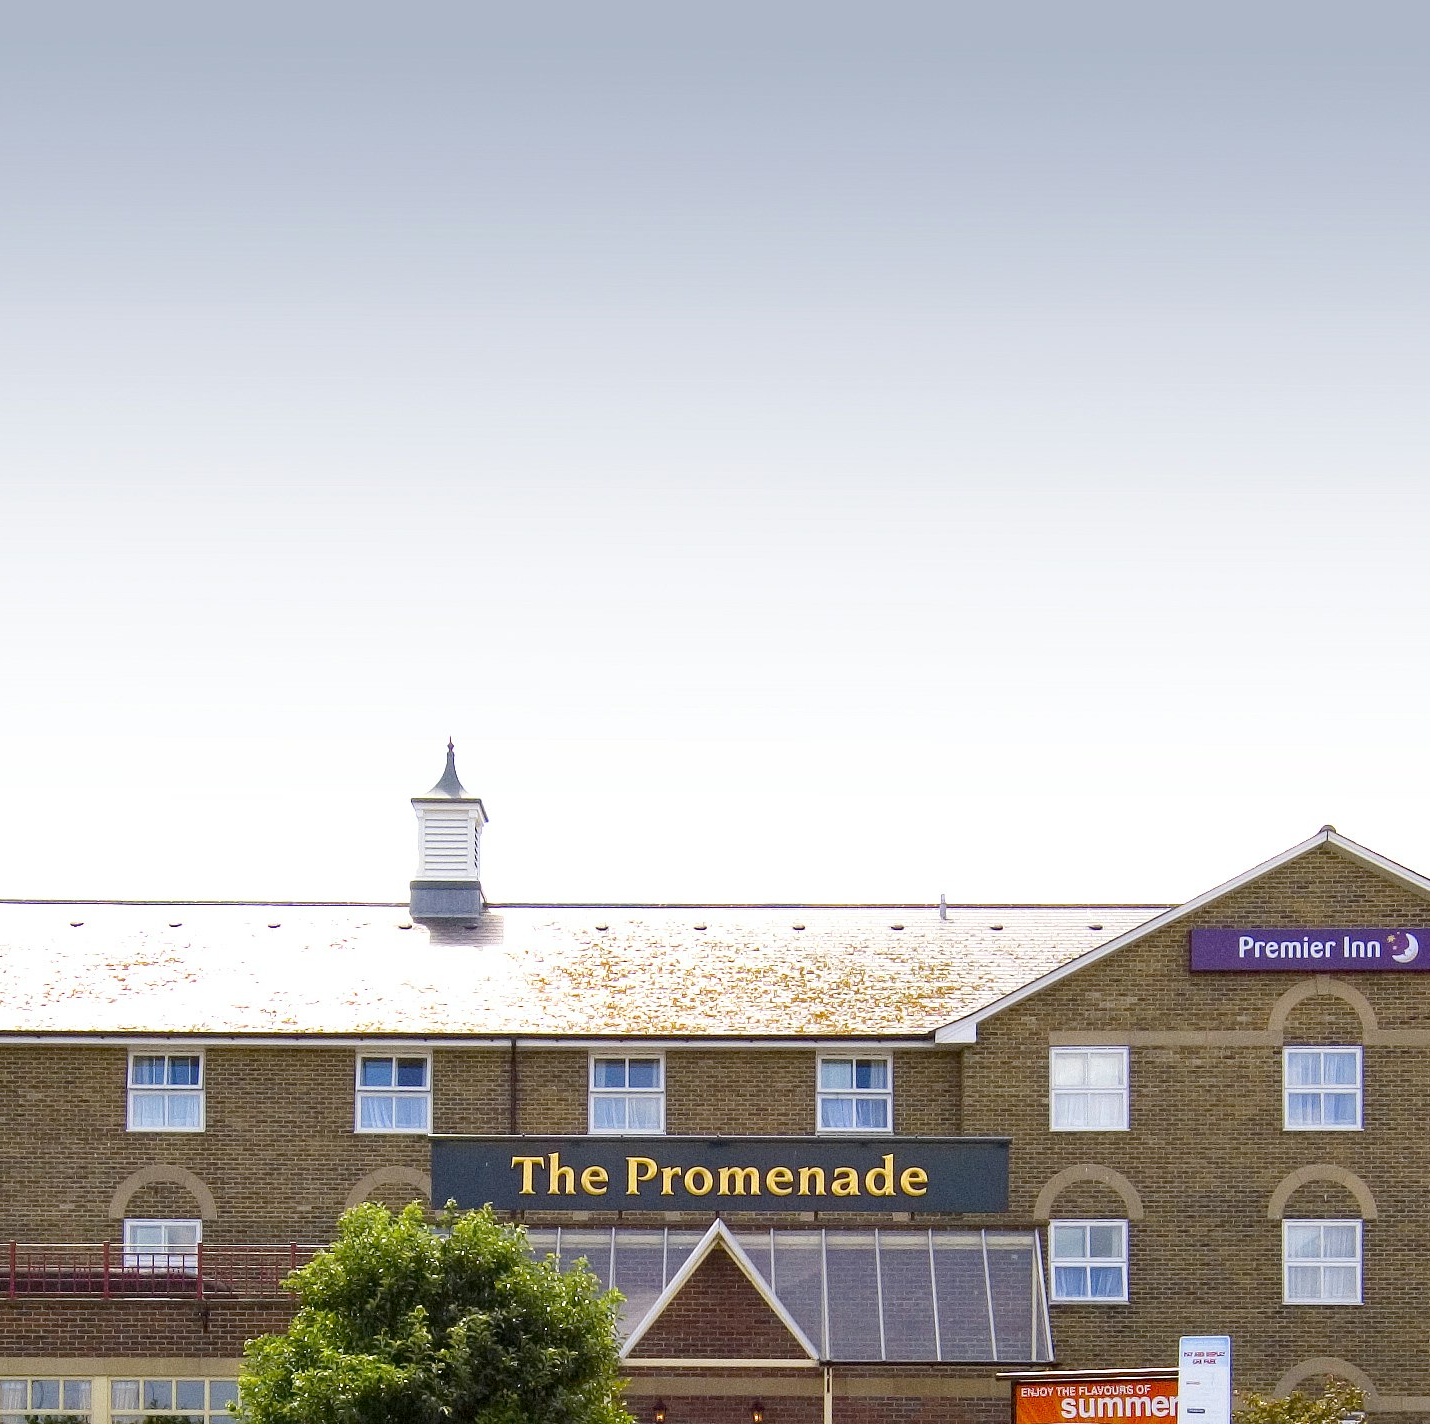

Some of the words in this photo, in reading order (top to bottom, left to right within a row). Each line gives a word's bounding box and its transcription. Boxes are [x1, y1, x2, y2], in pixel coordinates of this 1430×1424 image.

[1238, 936, 1337, 959] Premier
[1343, 936, 1381, 958] Inn
[510, 1152, 610, 1196] The
[625, 1153, 930, 1197] Promenade
[1021, 1387, 1054, 1398] ENJOY
[1056, 1386, 1076, 1397] THE
[1078, 1385, 1134, 1396] FLAVOURS
[1136, 1384, 1152, 1395] OF
[1060, 1395, 1179, 1419] summer
